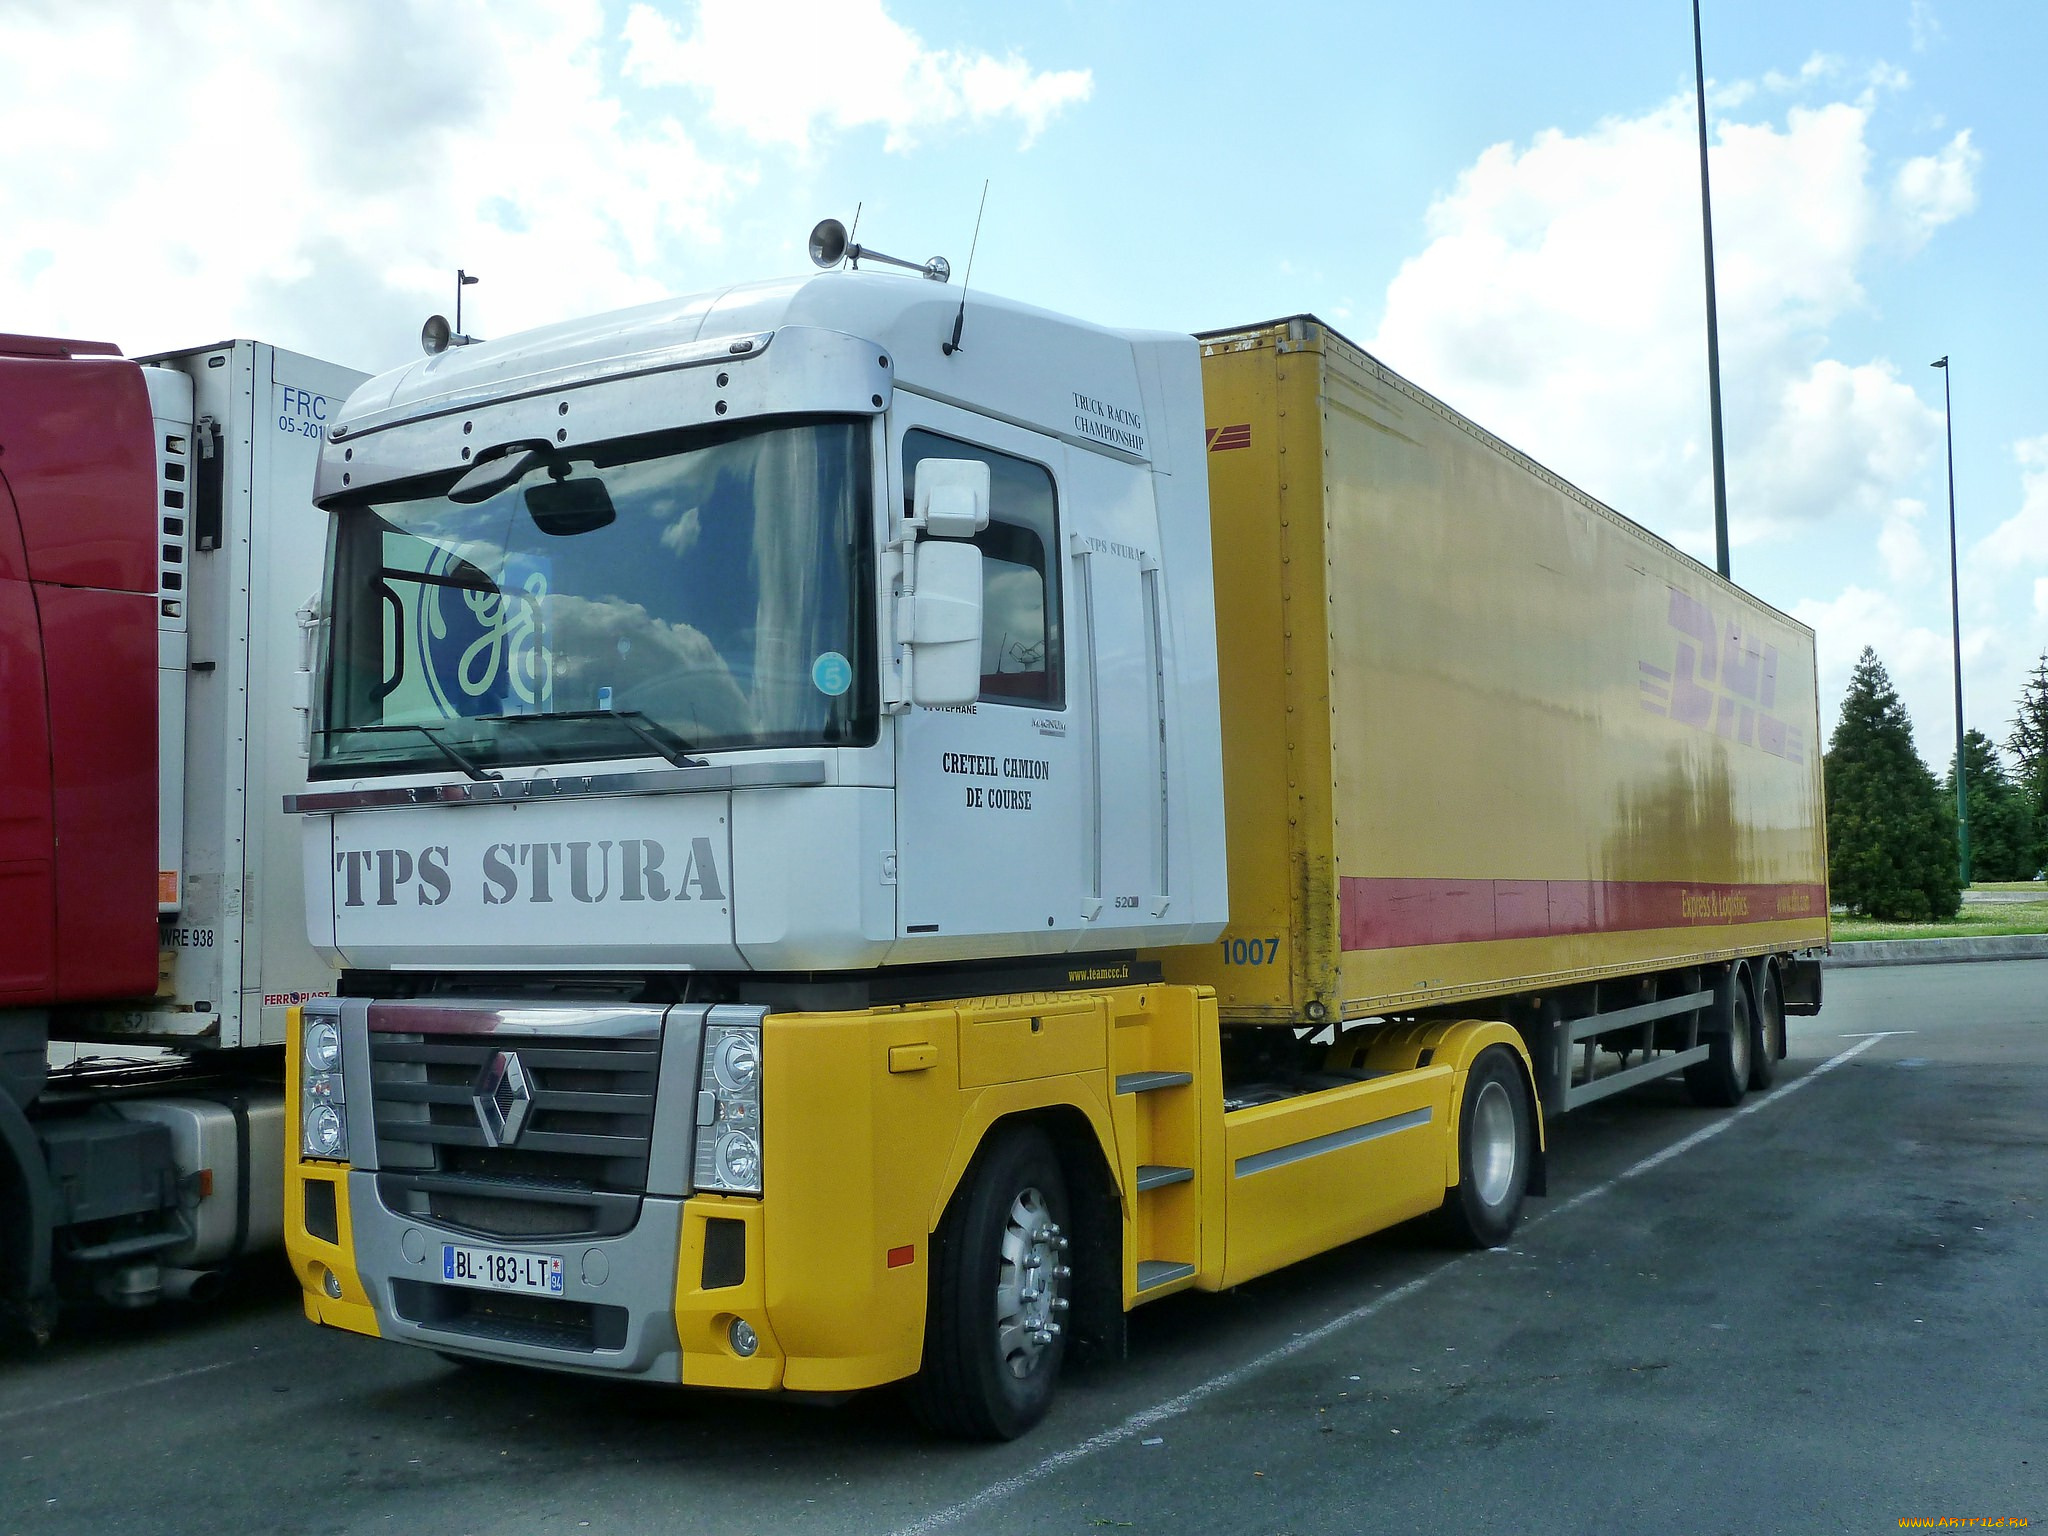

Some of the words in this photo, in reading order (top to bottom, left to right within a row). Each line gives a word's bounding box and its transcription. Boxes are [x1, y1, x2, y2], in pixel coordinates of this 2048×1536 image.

[283, 386, 327, 421] FRC
[1072, 392, 1104, 417] TRUCK
[1106, 404, 1141, 429] RACING
[278, 415, 323, 440] 05-201
[1074, 415, 1144, 451] CHAMPIONSHIP
[1087, 536, 1107, 554] TPS
[1110, 541, 1140, 561] STURA
[825, 667, 842, 690] 5
[1667, 586, 1788, 760] DHL
[1031, 717, 1066, 731] MAGNUM
[942, 752, 998, 776] CRETEIL
[1003, 757, 1049, 781] CAMION
[406, 776, 592, 803] RENAULT
[966, 787, 983, 808] DE
[987, 788, 1032, 810] COURSE
[336, 845, 451, 907] TPS
[482, 837, 726, 905] STURA
[1681, 889, 1711, 925] Express
[1719, 889, 1749, 925] Logistics
[161, 929, 189, 947] WRE
[192, 929, 214, 948] 938
[1221, 938, 1280, 966] 1007
[1068, 963, 1129, 982] www.teamccc.fr
[457, 1251, 548, 1287] BL-183-LT
[551, 1275, 561, 1289] 94
